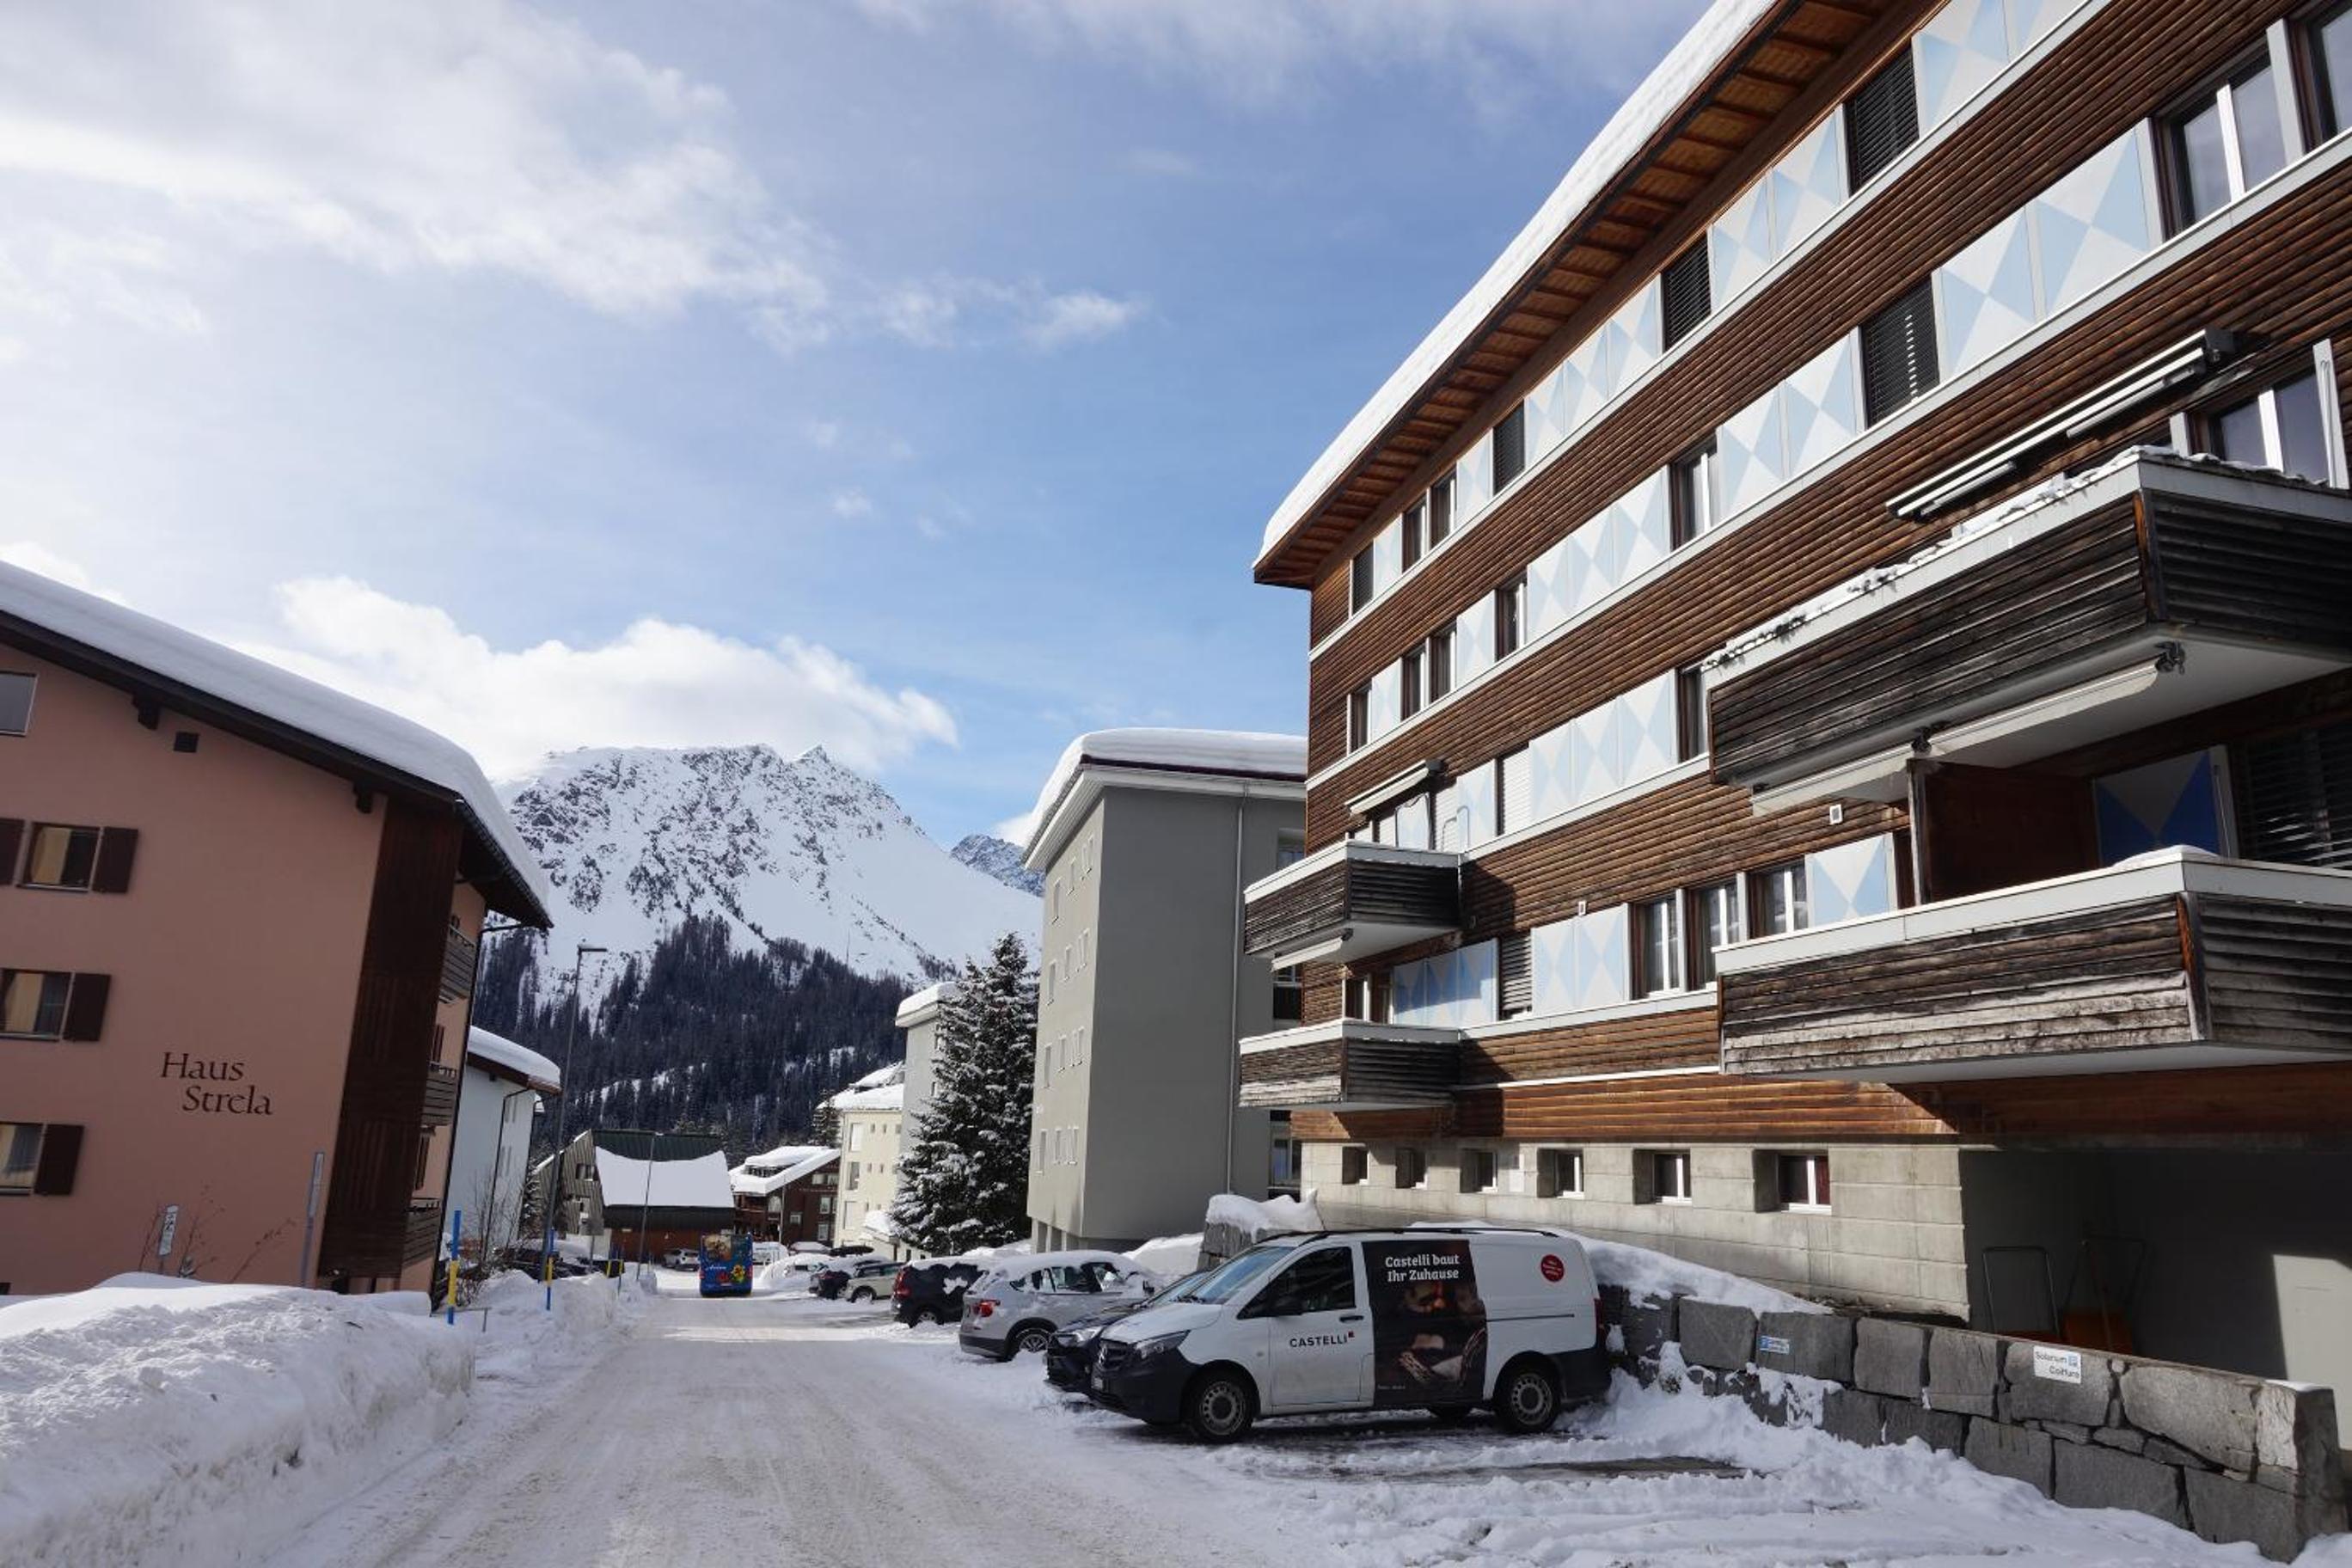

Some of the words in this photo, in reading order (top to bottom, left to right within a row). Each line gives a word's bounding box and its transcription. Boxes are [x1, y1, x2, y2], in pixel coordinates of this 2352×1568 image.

[161, 1051, 245, 1081] Haus
[182, 1085, 273, 1115] Strela
[1385, 1254, 1430, 1268] Castelli
[1432, 1254, 1460, 1265] baut
[1387, 1270, 1407, 1283] Ihr
[1409, 1268, 1459, 1281] Zuhause
[1289, 1333, 1348, 1348] CASTELLI
